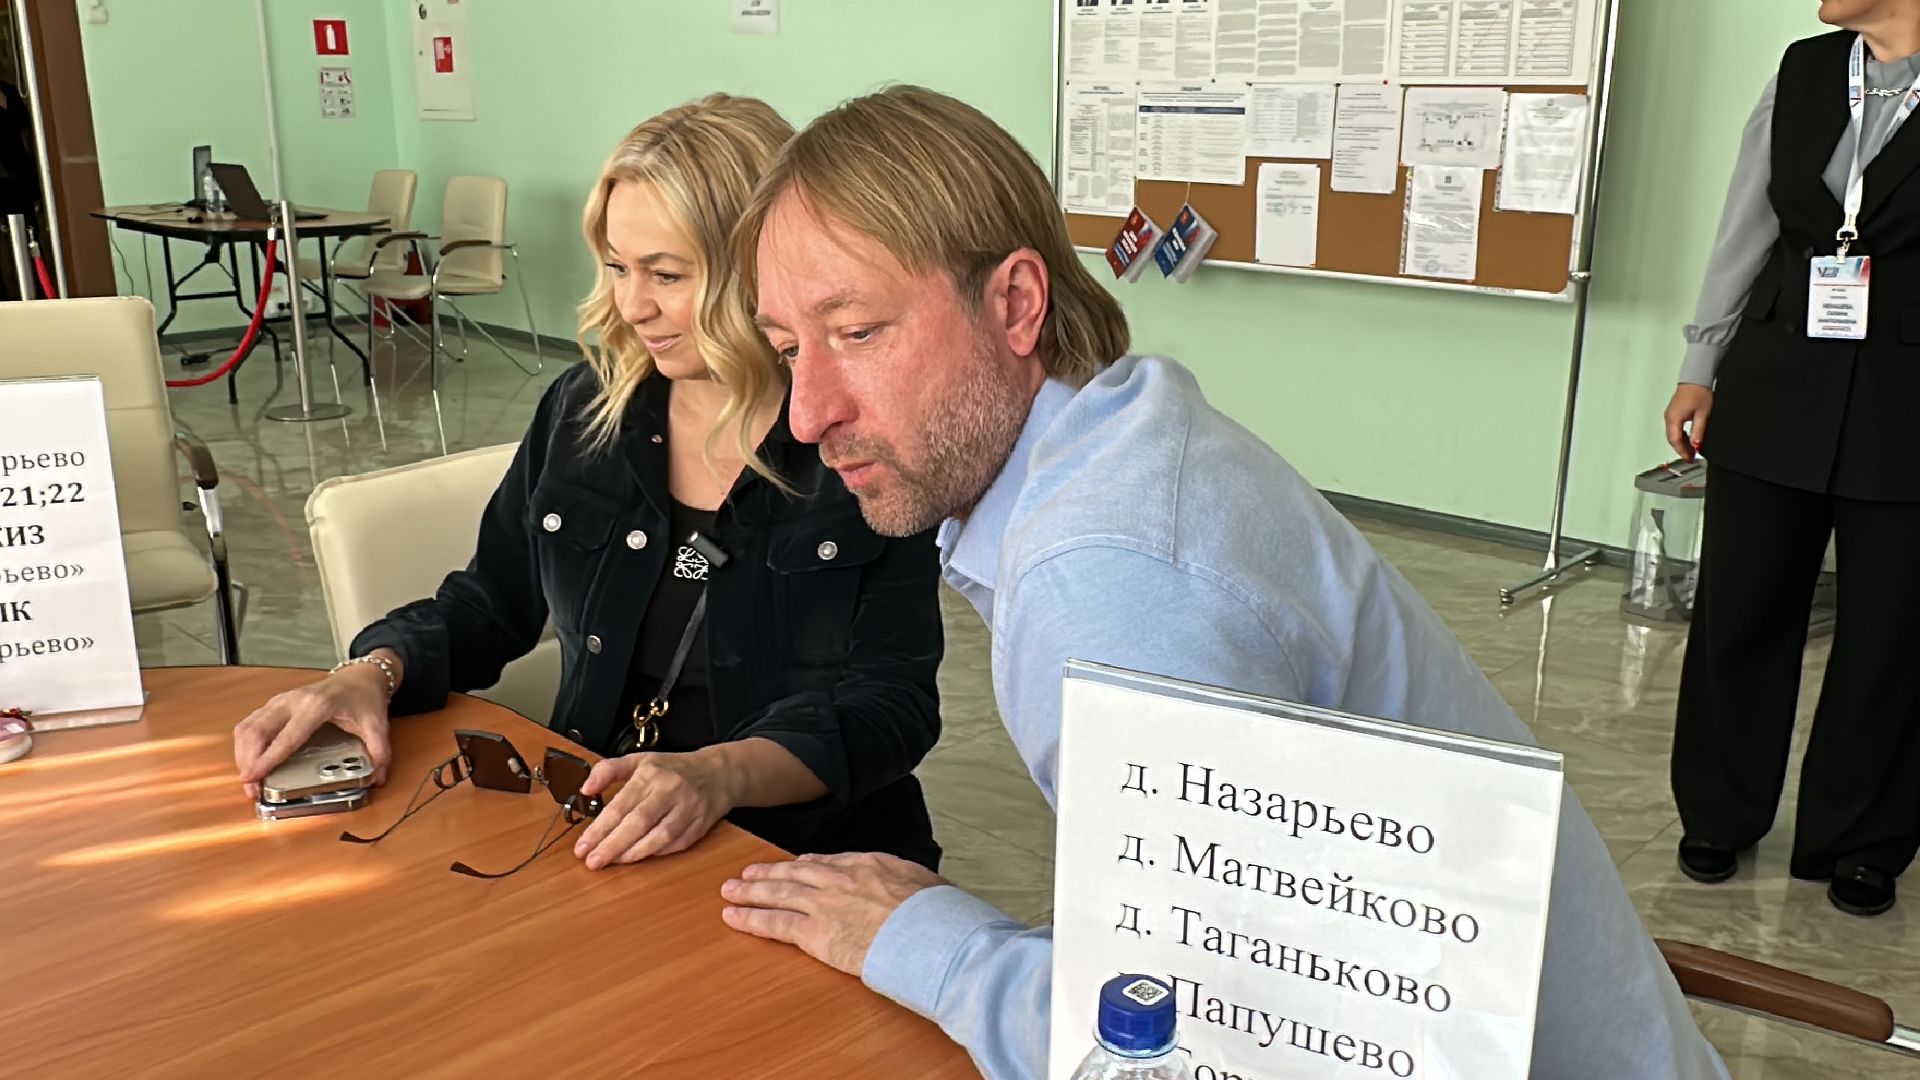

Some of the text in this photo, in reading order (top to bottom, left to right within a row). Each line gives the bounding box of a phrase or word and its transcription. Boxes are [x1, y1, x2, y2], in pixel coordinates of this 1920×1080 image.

[0, 482, 85, 507] 21;22
[0, 524, 45, 547] ИЗ
[0, 564, 85, 584] ьево»
[1121, 761, 1435, 854] д. Назарьево
[1117, 834, 1480, 944] д. Матвейково
[1115, 902, 1452, 1013] д. Таганьково
[1167, 973, 1415, 1078] Папушево
